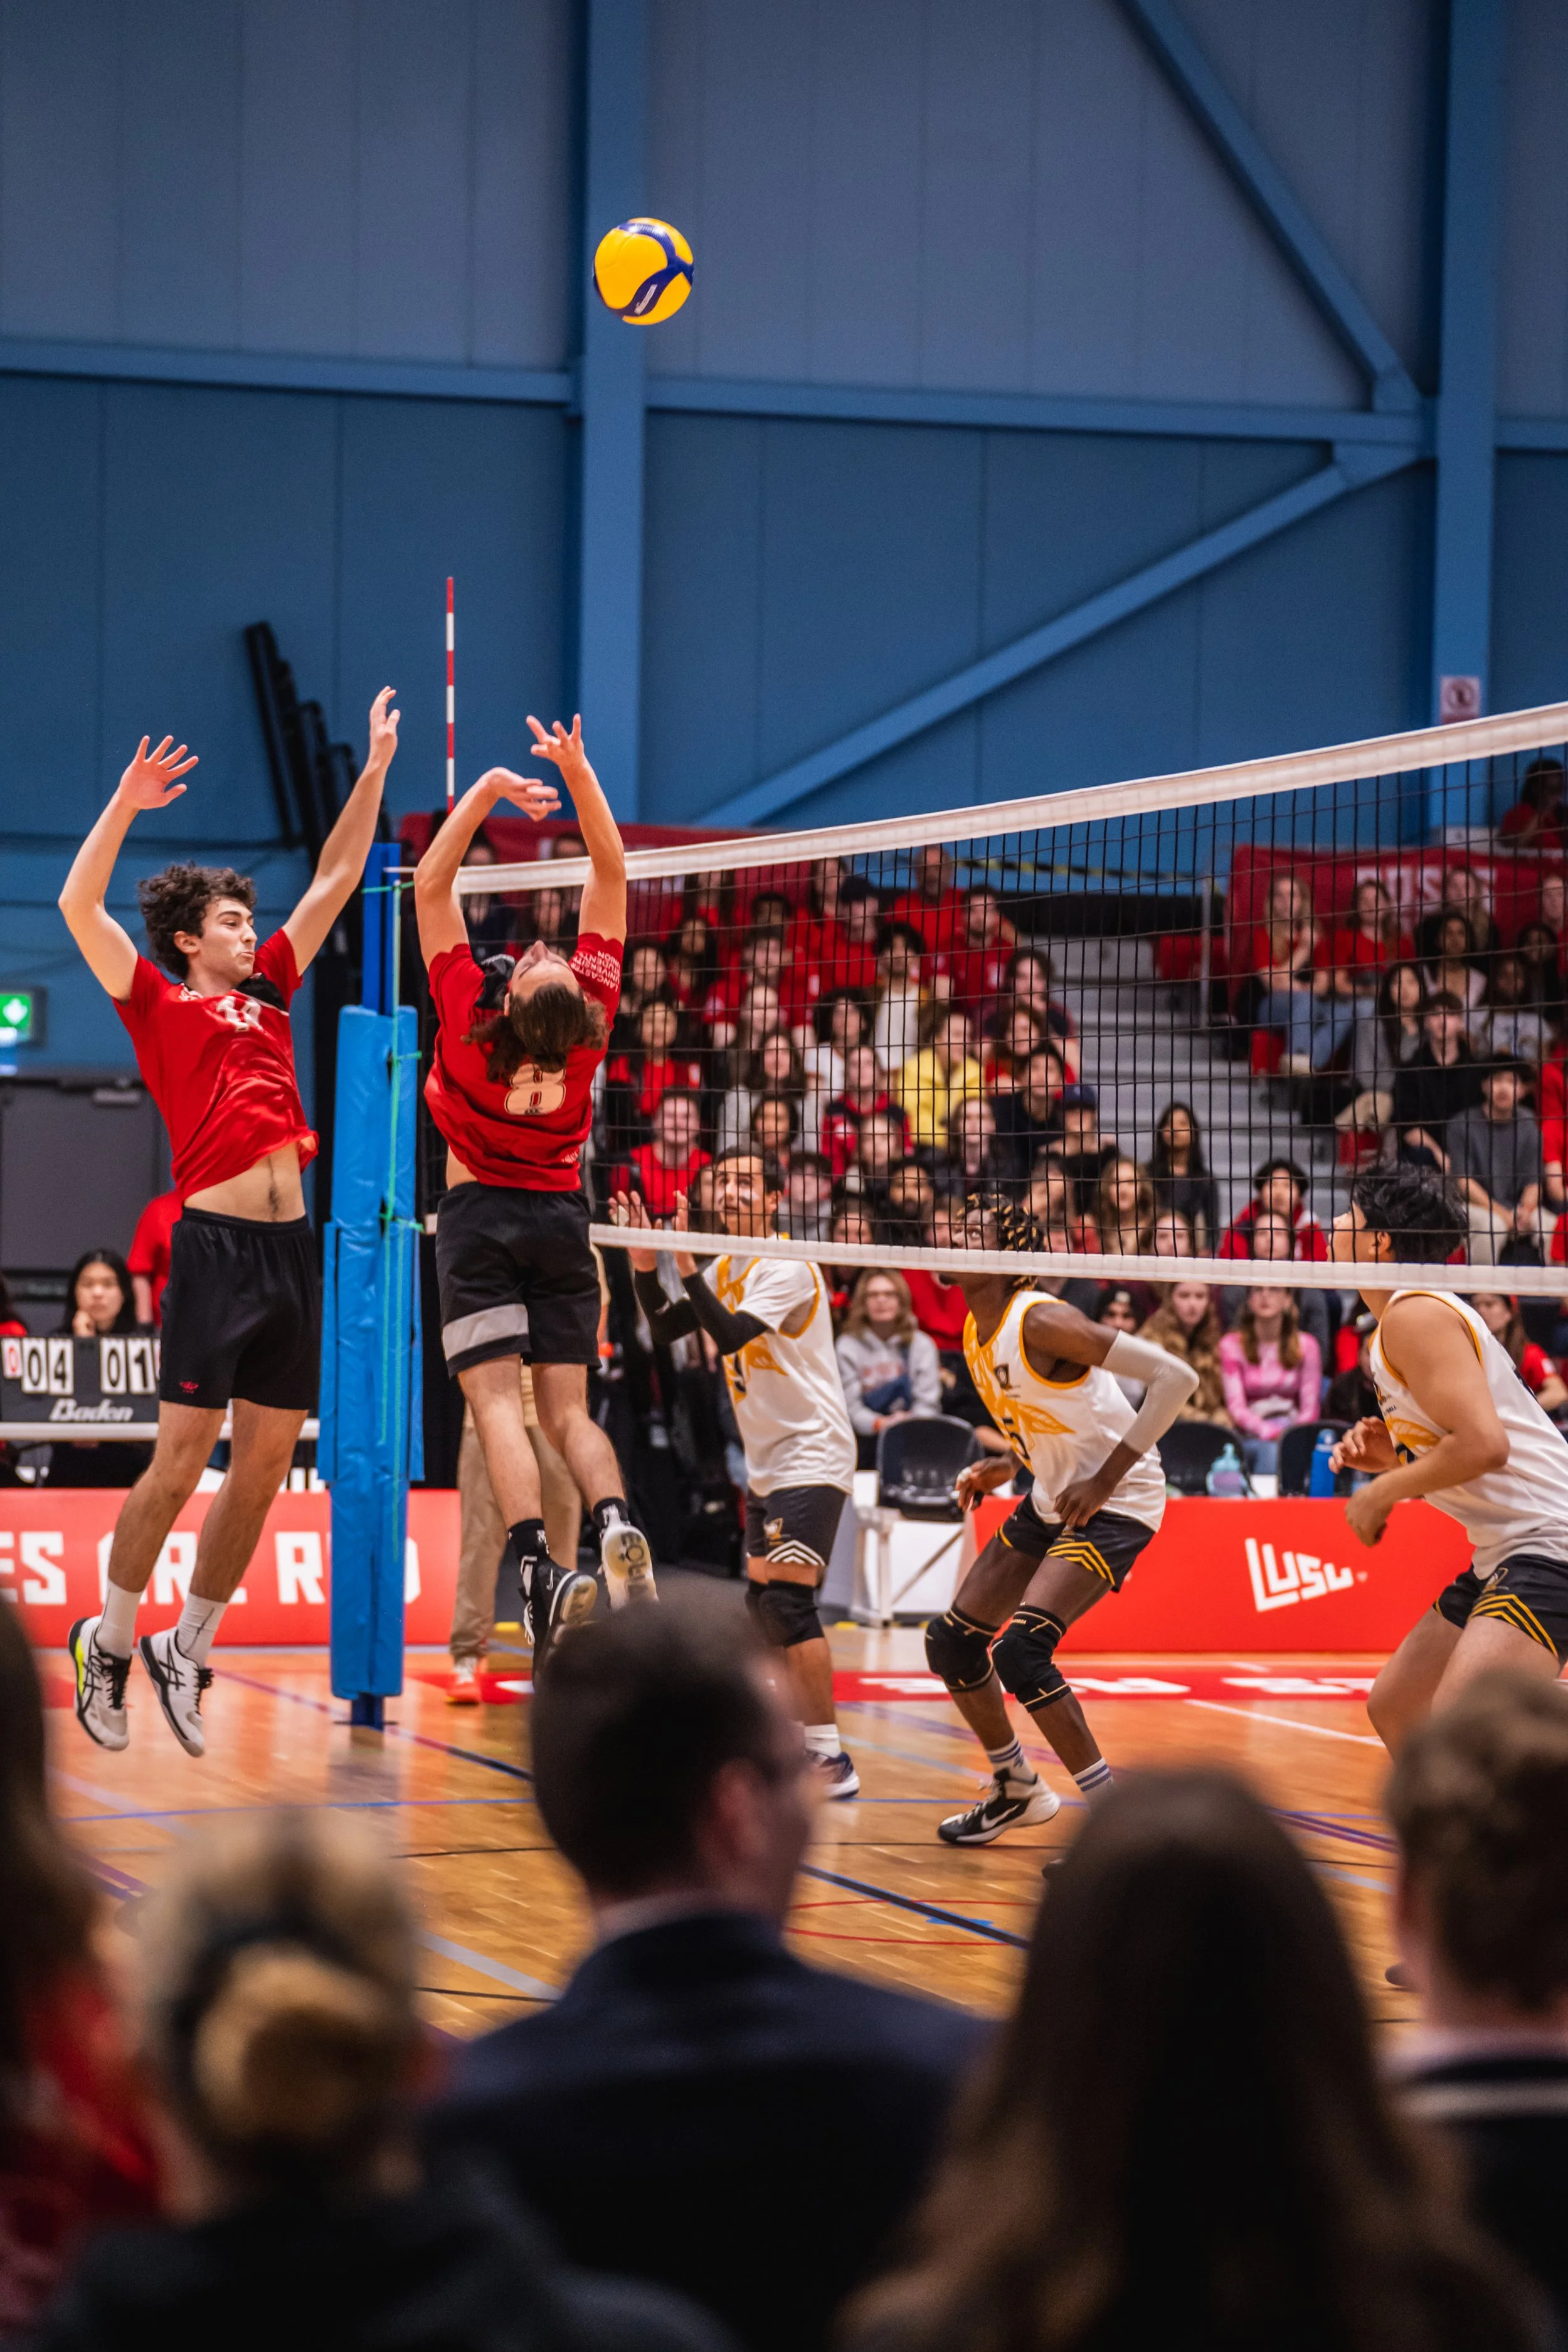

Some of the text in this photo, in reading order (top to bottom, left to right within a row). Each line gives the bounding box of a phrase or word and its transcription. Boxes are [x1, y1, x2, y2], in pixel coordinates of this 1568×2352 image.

[573, 956, 620, 985] UNIVERSITY
[598, 950, 620, 970] UNION
[570, 962, 618, 992] LANCASTER
[504, 1063, 566, 1115] 8
[28, 1348, 149, 1389] 04 01
[48, 1397, 134, 1422] Baden
